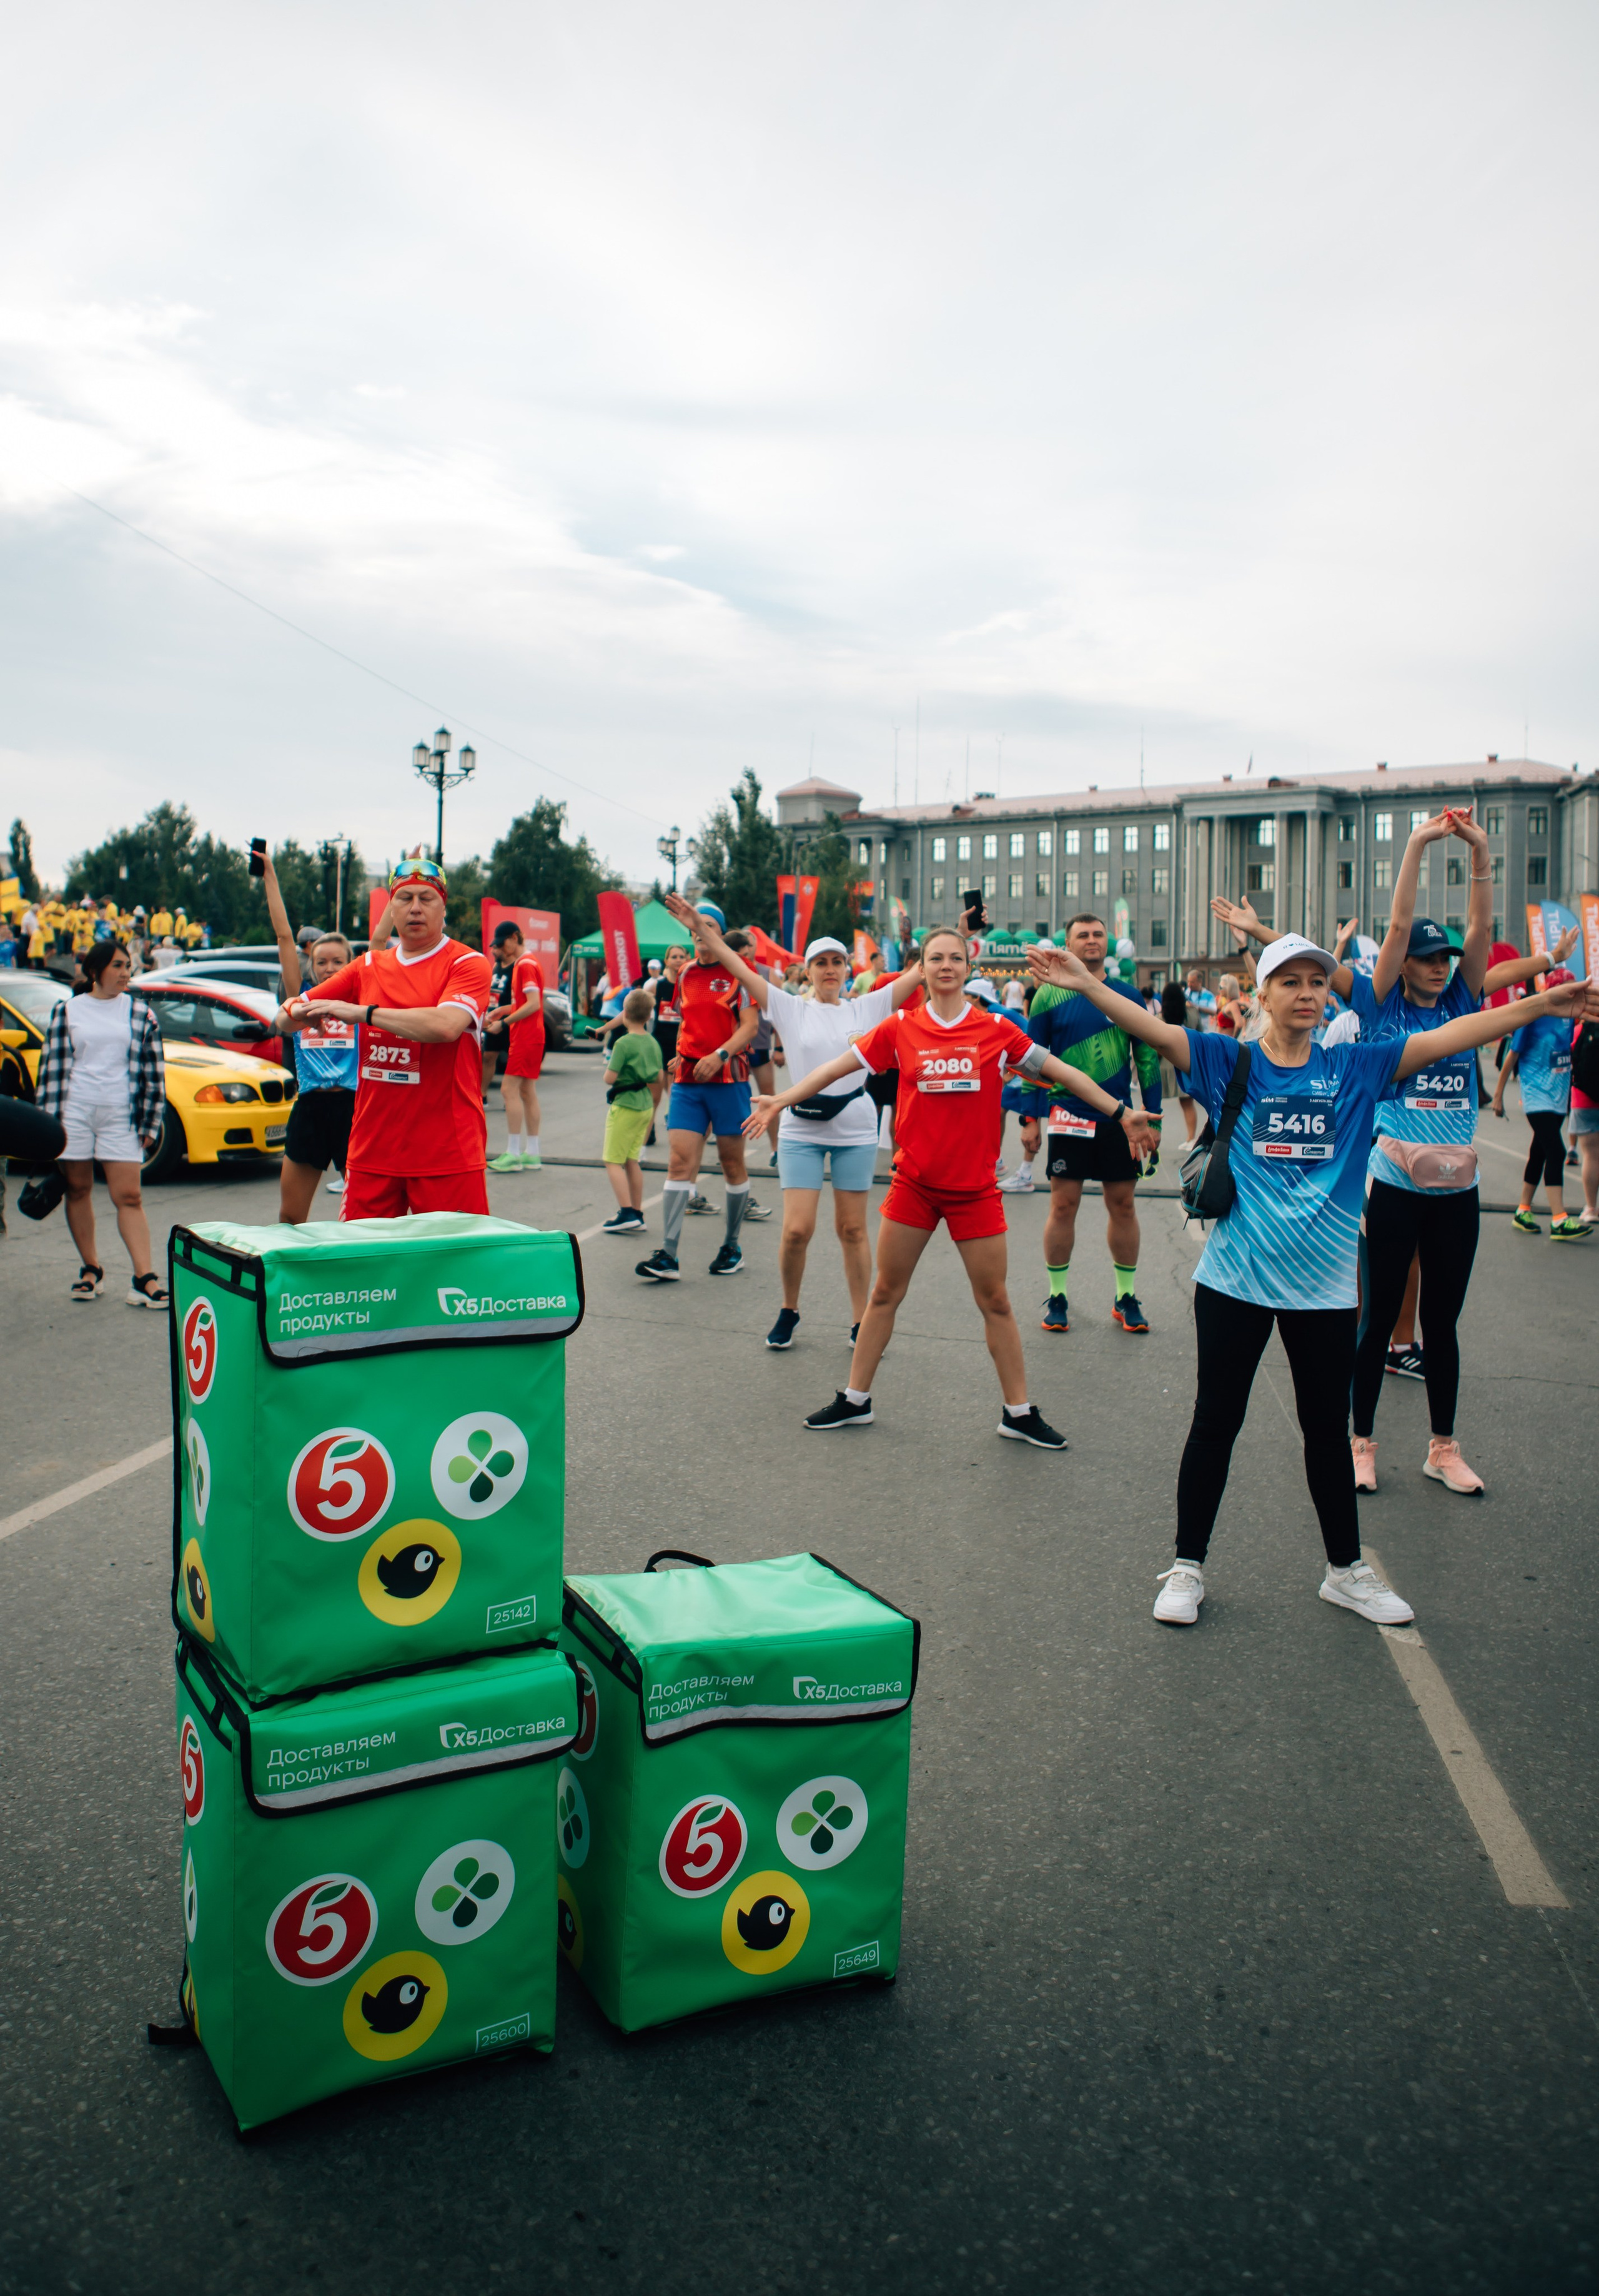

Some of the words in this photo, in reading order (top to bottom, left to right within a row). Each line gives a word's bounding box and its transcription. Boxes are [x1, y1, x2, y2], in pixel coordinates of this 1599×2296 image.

[369, 1045, 410, 1064] 2873
[923, 1058, 973, 1074] 2080
[1415, 1075, 1464, 1091] 5420
[1267, 1113, 1325, 1135] 5416
[279, 1288, 397, 1314] Доставляем
[280, 1311, 370, 1335] продукты
[317, 1435, 370, 1520] 5
[494, 1604, 530, 1625] 25142
[648, 1675, 755, 1701] Доставляем
[649, 1691, 728, 1719] продукты
[267, 1731, 396, 1769] Доставляем
[268, 1757, 369, 1789] продукты
[683, 1802, 725, 1878] 5
[297, 1882, 352, 1965] 5
[838, 1949, 876, 1970] 25649
[481, 2021, 526, 2047] 25600
